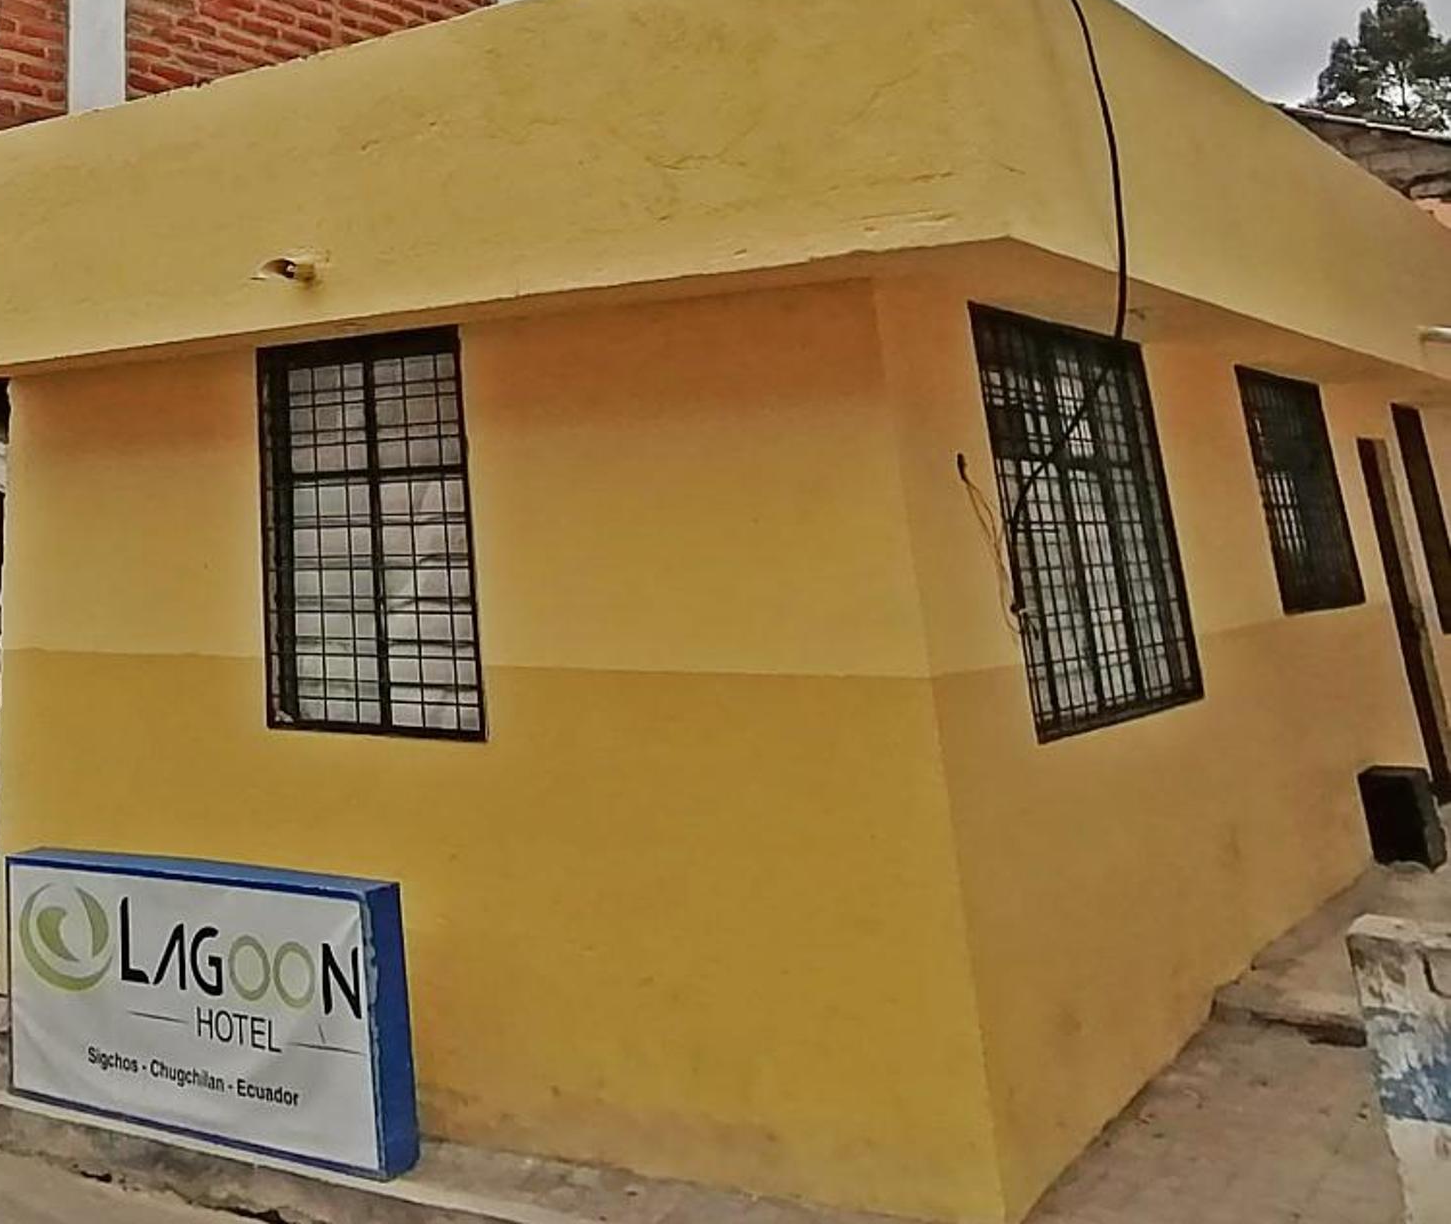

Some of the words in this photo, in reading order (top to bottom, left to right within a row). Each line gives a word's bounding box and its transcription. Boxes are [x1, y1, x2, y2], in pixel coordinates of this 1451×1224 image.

[119, 897, 362, 1019] LAGOON
[196, 1006, 282, 1053] HOTEL
[88, 1047, 138, 1073] Sigchos
[236, 1079, 299, 1106] Ecuador
